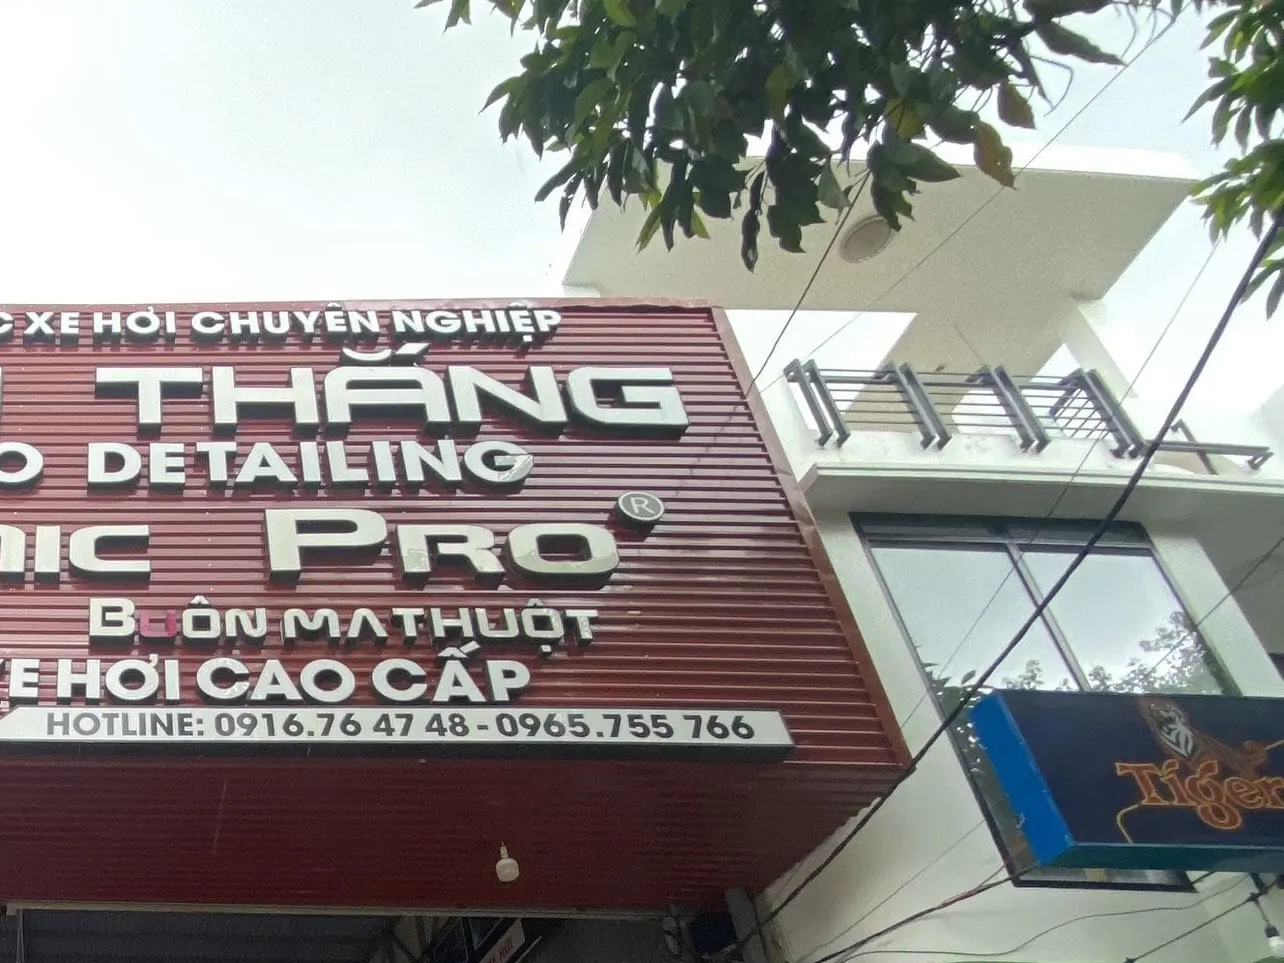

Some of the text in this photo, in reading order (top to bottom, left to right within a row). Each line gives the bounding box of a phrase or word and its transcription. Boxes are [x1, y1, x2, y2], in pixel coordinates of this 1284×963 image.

[23, 310, 80, 337] XE
[93, 307, 177, 336] HƠI
[191, 303, 381, 337] CHUYÊN
[395, 303, 562, 344] NGHIỆP
[95, 342, 690, 430] THẮNG
[88, 440, 534, 486] DETAILING
[264, 508, 620, 578] PRO
[88, 596, 601, 655] BUÔN MA THUỘT
[57, 652, 181, 703] HƠI
[195, 658, 357, 705] CAO
[371, 639, 532, 706] CẤP
[46, 712, 206, 738] HOTLINE:
[215, 713, 363, 739] 0916.76
[373, 713, 414, 739] 47
[424, 713, 471, 740] 48
[495, 714, 676, 740] 0965.755
[683, 715, 756, 741] 766
[1116, 759, 1284, 830] Tiger
